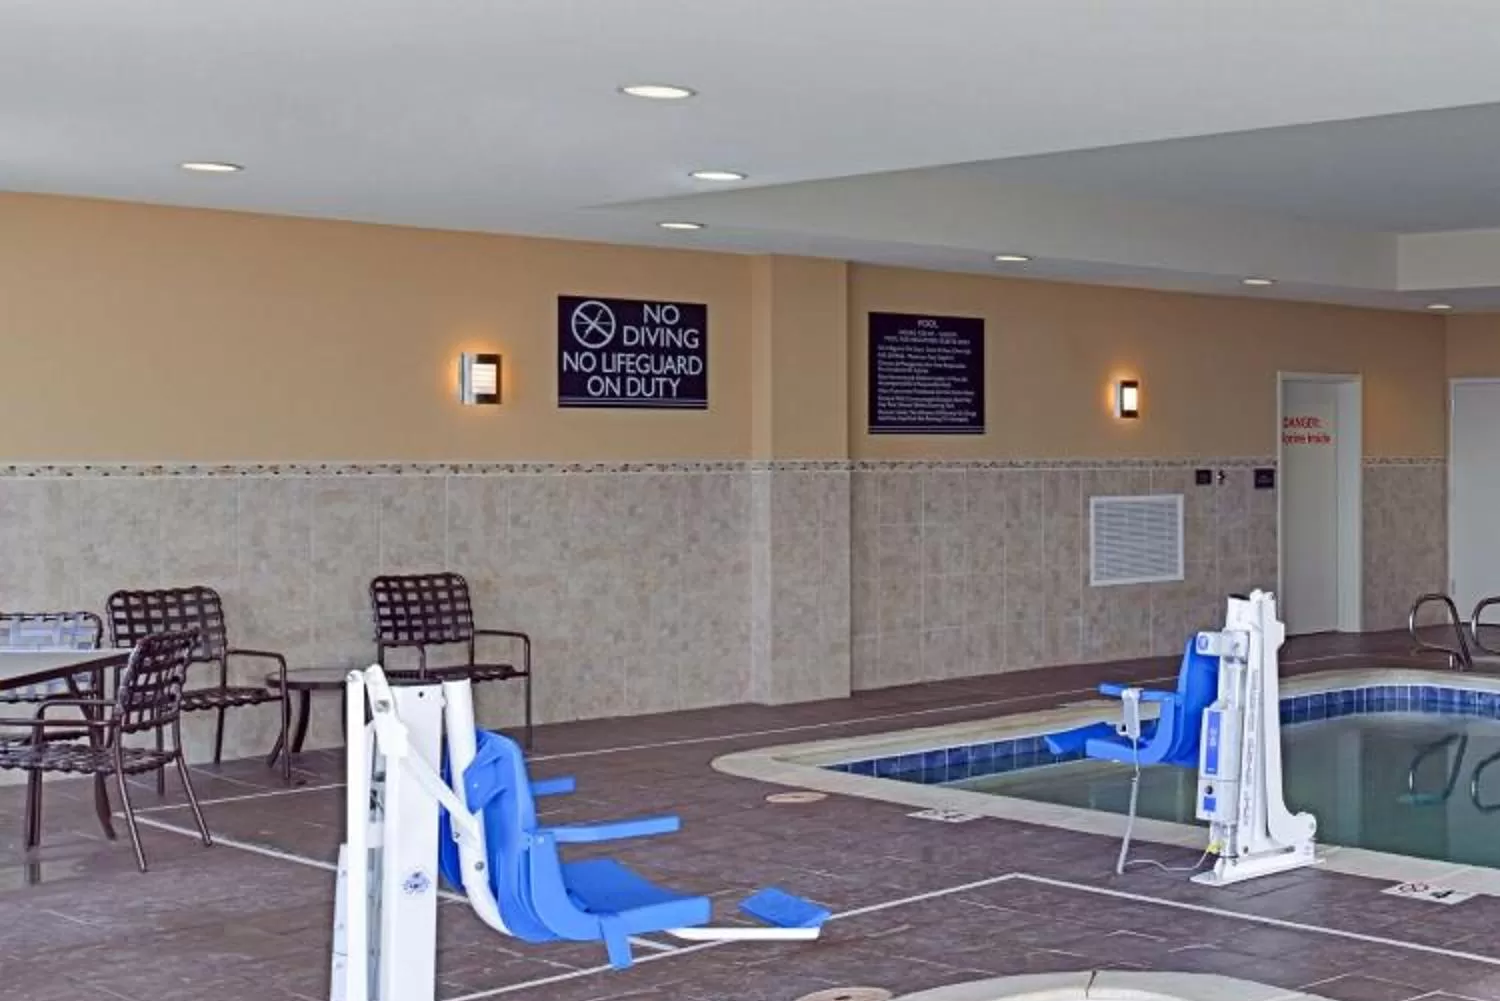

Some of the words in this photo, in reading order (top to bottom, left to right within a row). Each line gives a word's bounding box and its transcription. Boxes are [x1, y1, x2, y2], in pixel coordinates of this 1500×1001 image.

[643, 303, 680, 325] NO
[623, 325, 699, 349] DIVING
[563, 351, 597, 374] NO
[601, 352, 703, 375] LIFEGUARD
[587, 375, 621, 397] ON
[626, 376, 681, 398] DUTY
